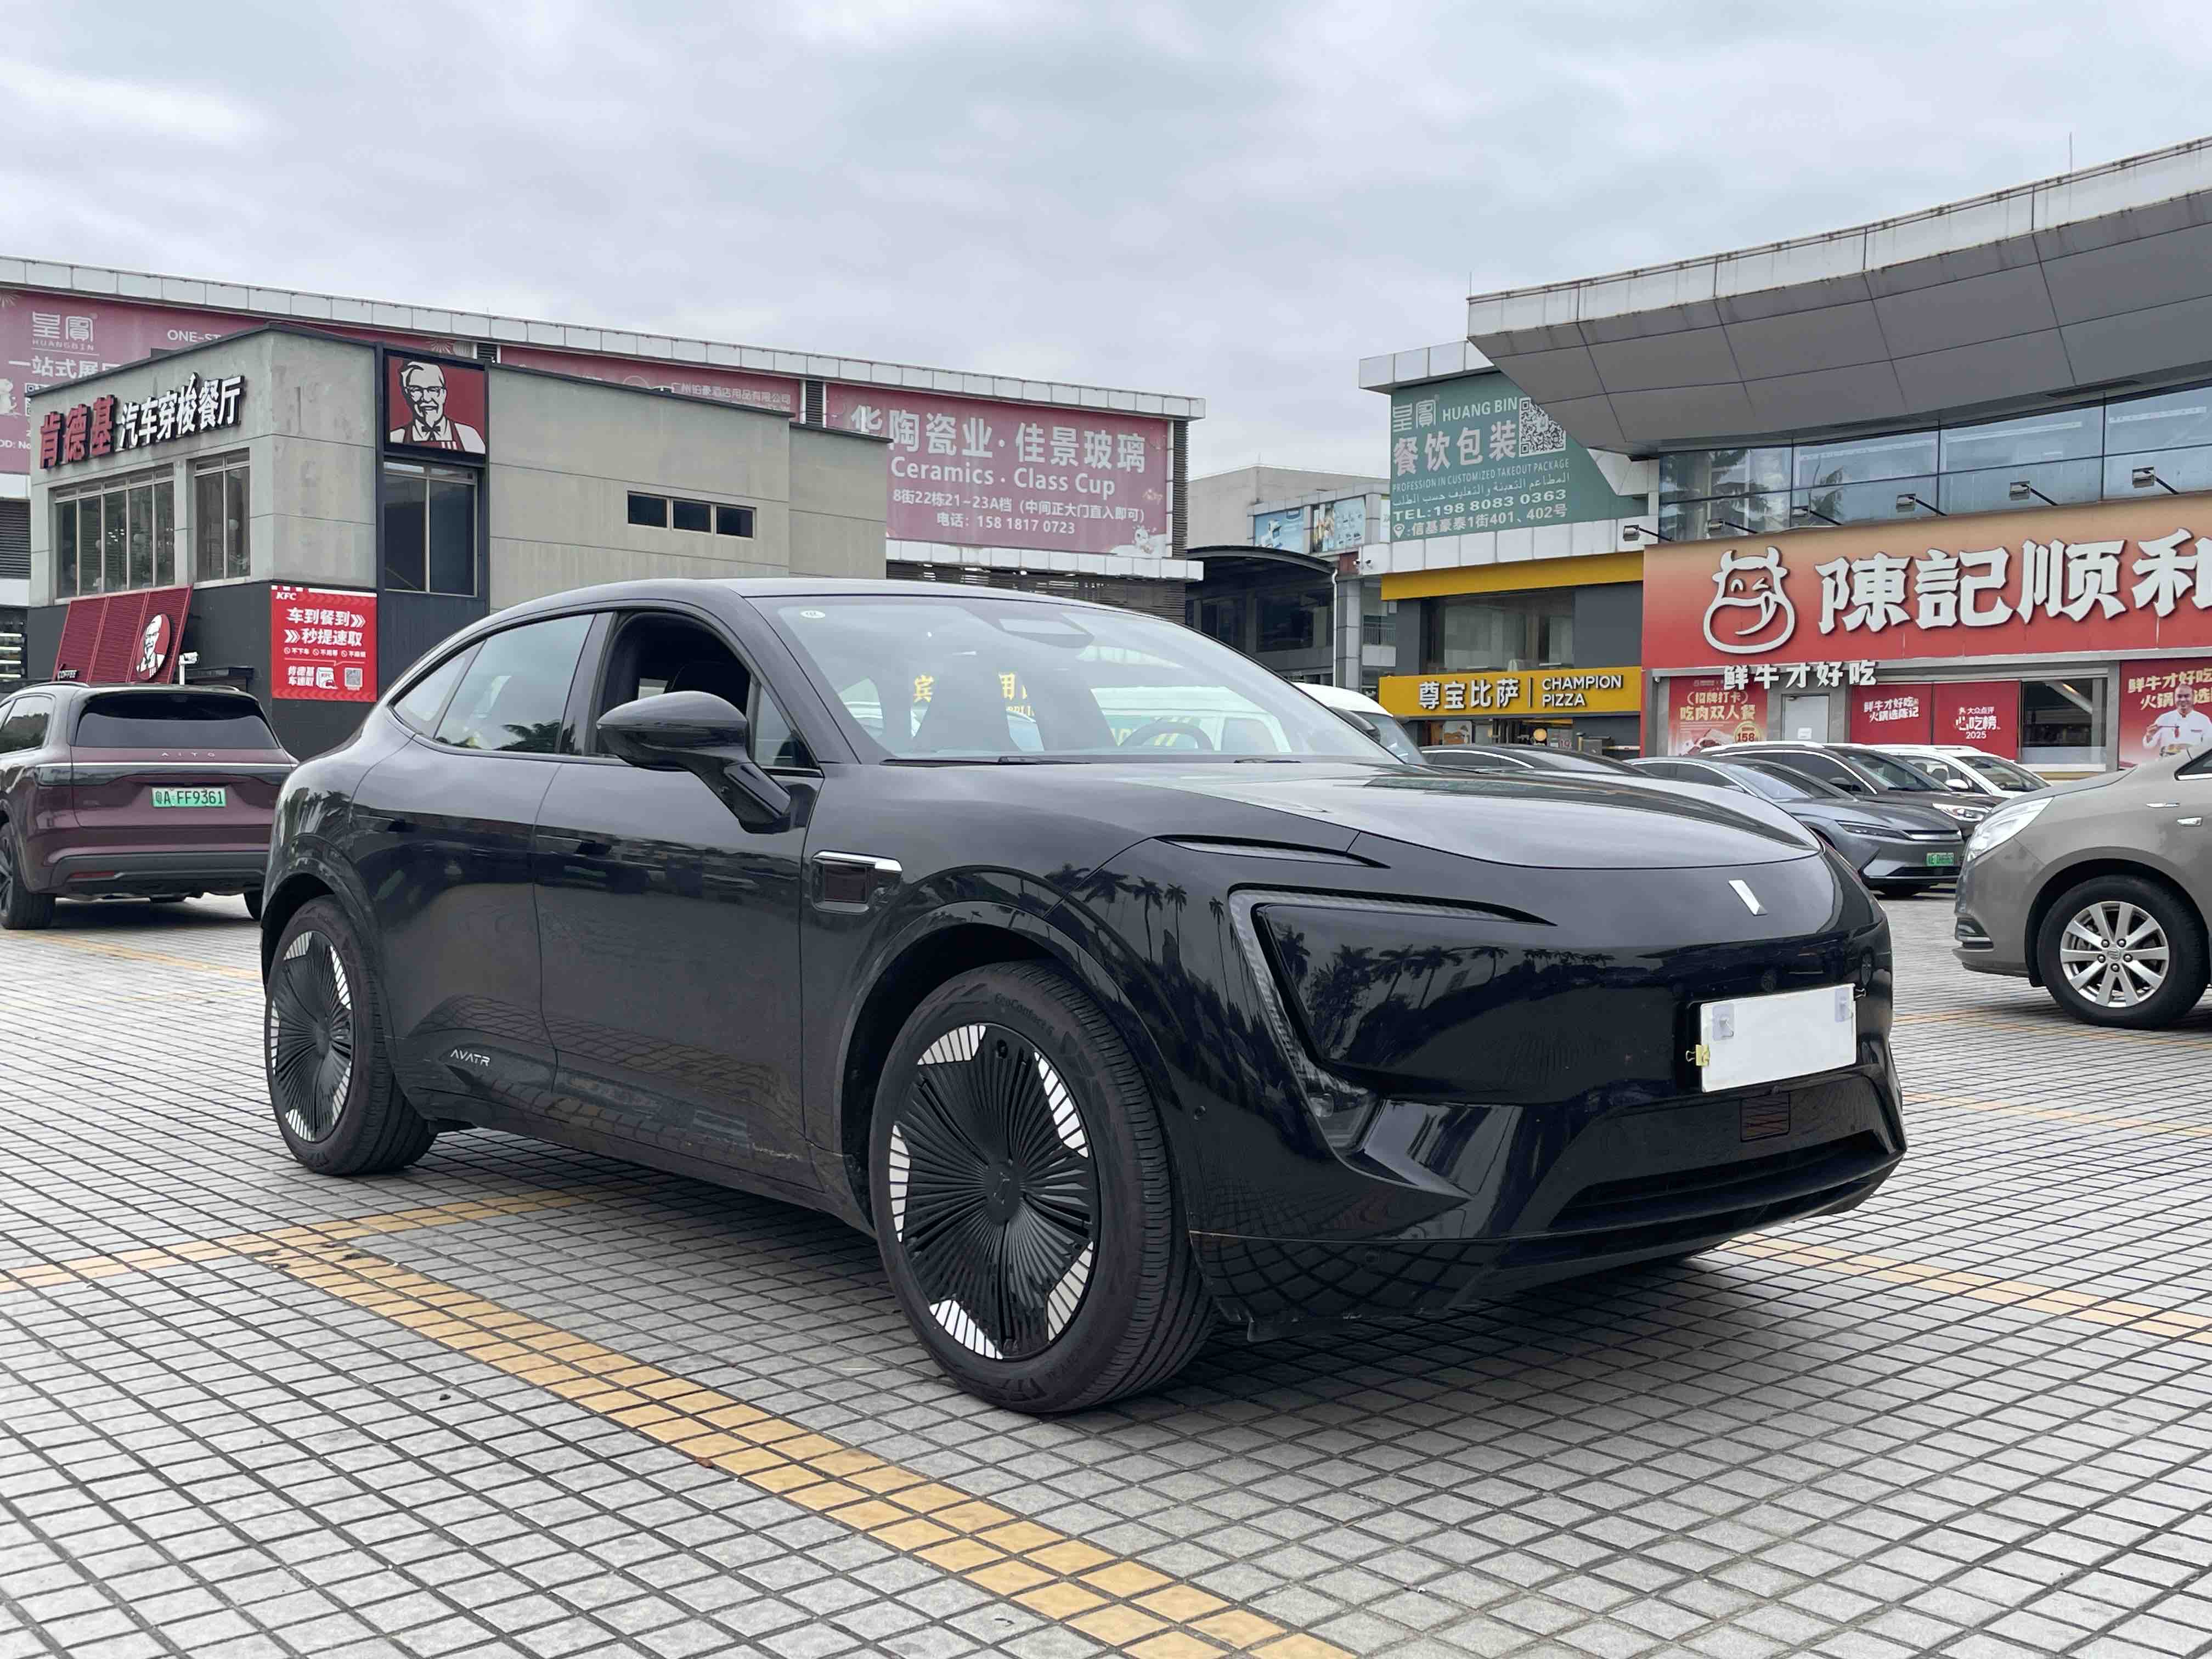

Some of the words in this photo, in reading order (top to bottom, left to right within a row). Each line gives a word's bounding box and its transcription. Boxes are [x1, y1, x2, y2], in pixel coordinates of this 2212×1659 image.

[32, 338, 94, 351] HUANGBIN
[1442, 402, 1491, 422] HUANG
[1494, 397, 1518, 414] BIN
[40, 393, 115, 470] 肯德基
[116, 372, 242, 450] 汽车穿梭餐厅
[1392, 420, 1517, 477] 餐饮包装
[891, 456, 994, 485] Ceramics
[1013, 467, 1069, 492] Class
[1075, 473, 1115, 501] Cup
[1392, 478, 1436, 493] PROFESSION
[1438, 476, 1446, 487] IN
[1448, 469, 1496, 485] CUSTOMIZED
[1497, 464, 1532, 477] TAKEOUT
[1533, 458, 1570, 473] PACKAGE
[1470, 496, 1514, 511] 8083
[1520, 489, 1566, 505] 0363
[977, 515, 1002, 529] 158
[1007, 518, 1039, 532] 1817
[1043, 521, 1075, 534] 0723
[276, 592, 297, 601] KFC
[285, 607, 351, 627] 车到餐到
[301, 628, 363, 647] 秒提速取
[1542, 675, 1622, 691] CHAMPION
[1723, 660, 1878, 691] 鲜牛才好吃
[2128, 668, 2212, 693] 鲜牛才好吃
[1419, 678, 1519, 710] 尊宝比萨
[1542, 693, 1586, 708] PIZZA
[1680, 704, 1756, 721] 吃肉双人餐
[1864, 696, 1914, 713] 鲜牛才好吃
[1737, 732, 1755, 742] 158
[1966, 731, 1987, 740] 2025
[450, 1048, 490, 1066] AVATR
